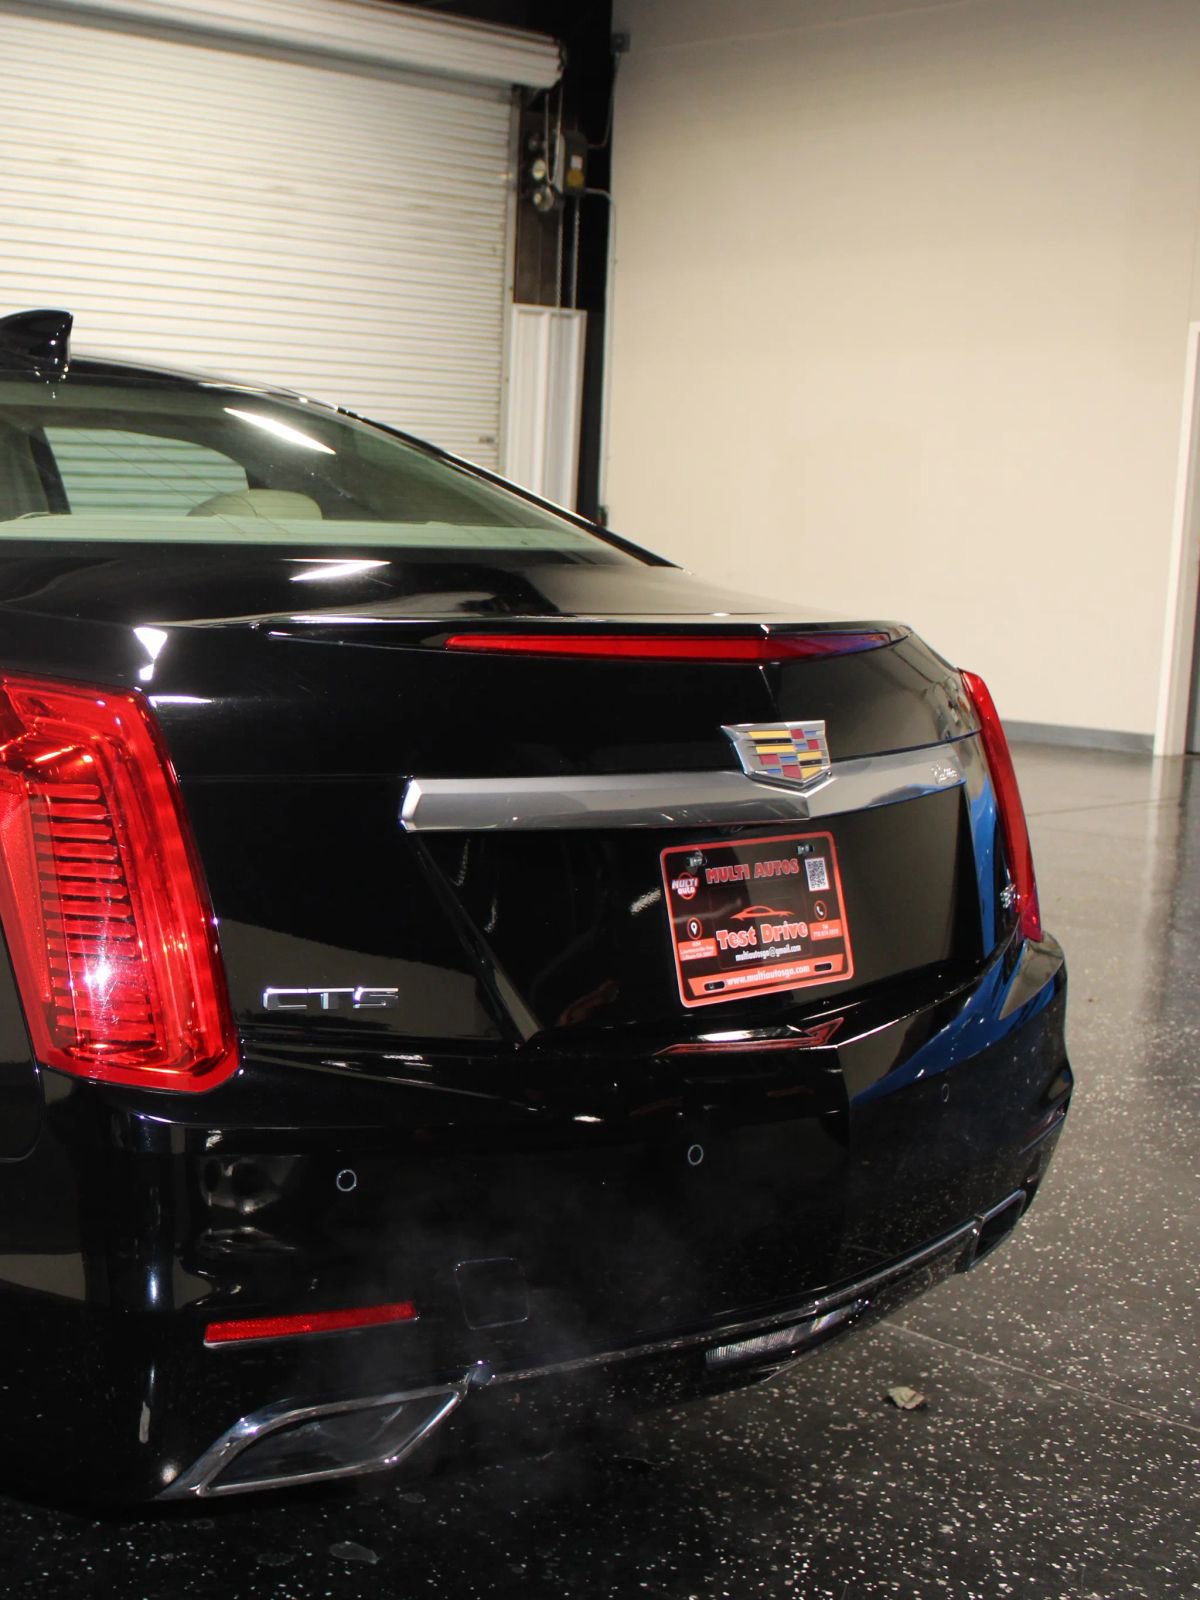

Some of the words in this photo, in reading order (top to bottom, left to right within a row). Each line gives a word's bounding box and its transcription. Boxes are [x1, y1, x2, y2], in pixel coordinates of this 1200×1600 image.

[671, 877, 698, 890] MULTI
[705, 864, 750, 884] MULTI
[754, 859, 800, 878] AUTOS
[715, 927, 757, 950] Test
[760, 921, 808, 944] Drive
[263, 987, 399, 1010] CTS
